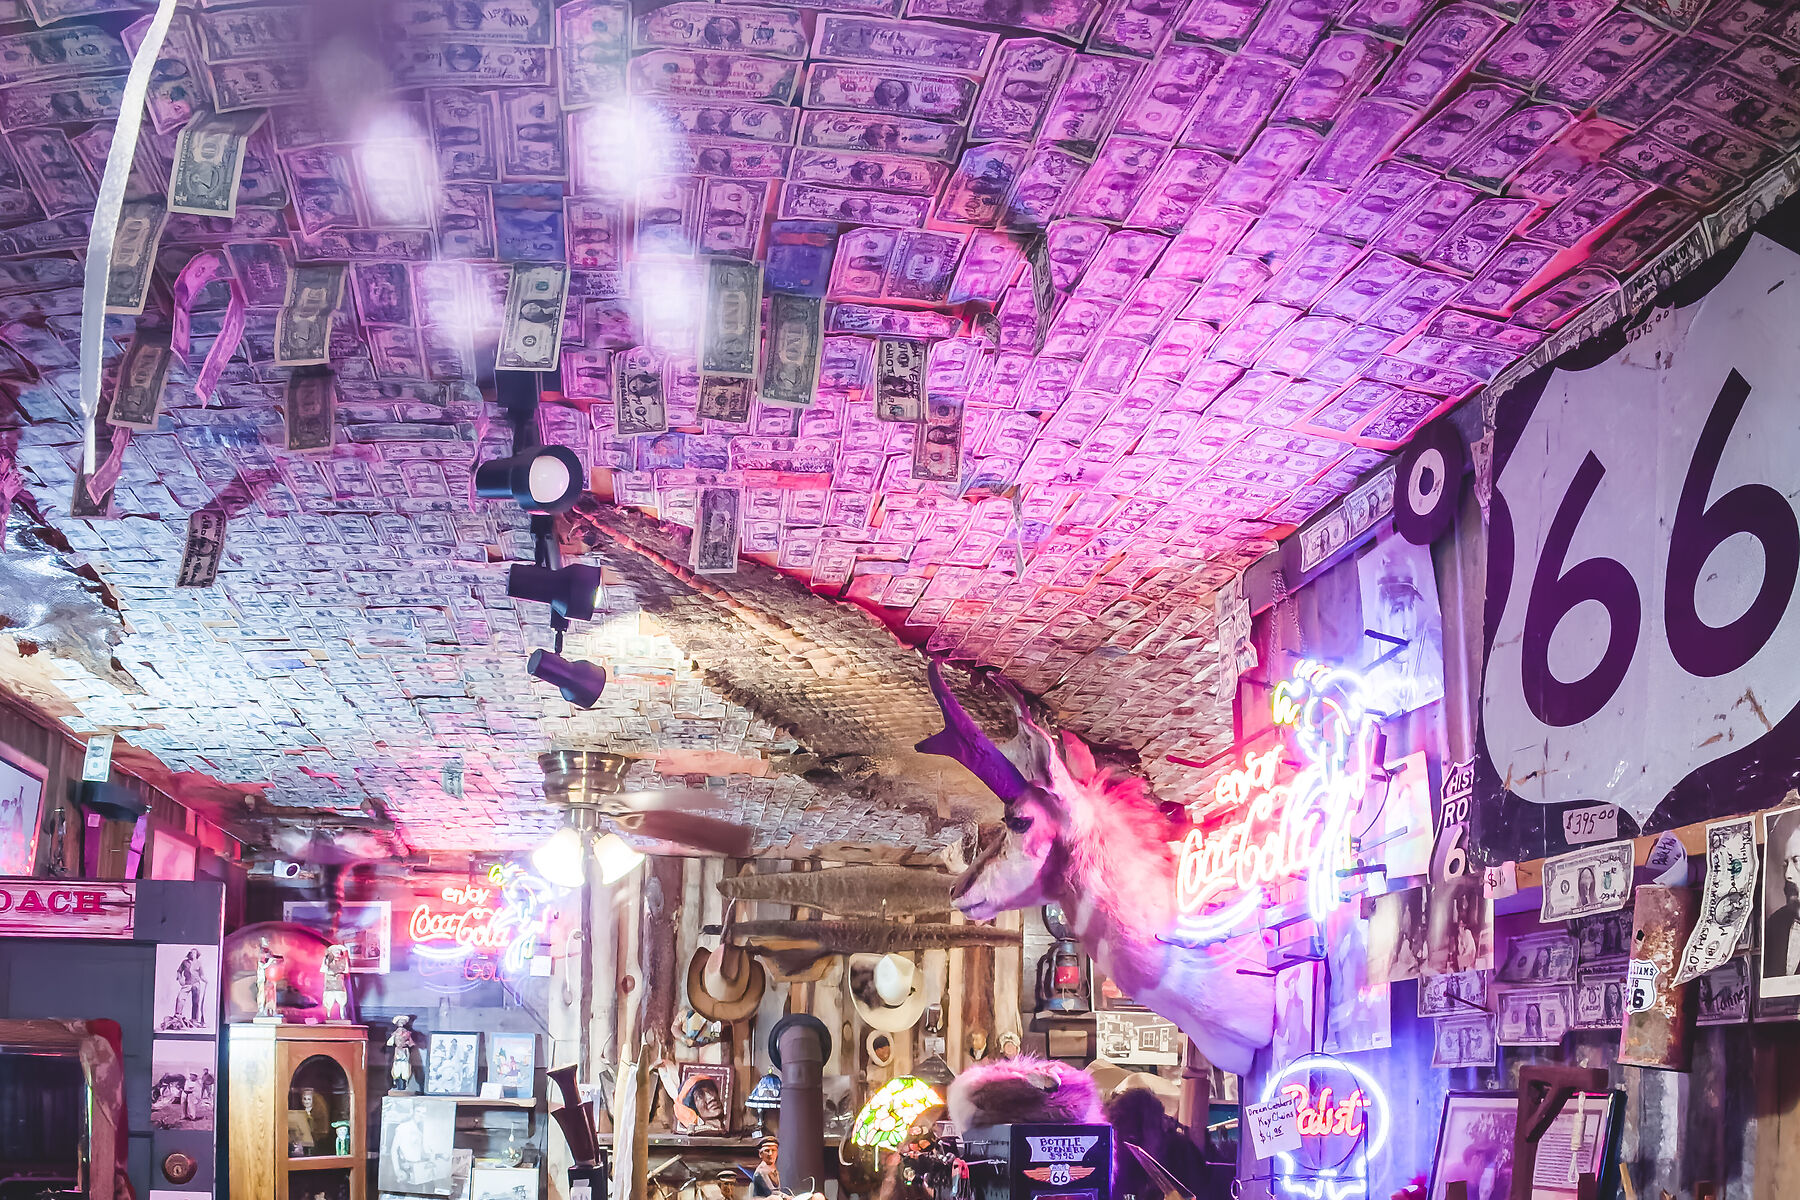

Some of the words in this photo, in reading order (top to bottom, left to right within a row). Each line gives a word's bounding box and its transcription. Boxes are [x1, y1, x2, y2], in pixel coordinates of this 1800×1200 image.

[1521, 367, 1800, 677] 66
[441, 884, 490, 905] enjoy
[1281, 1084, 1371, 1137] Pabst
[1040, 1137, 1081, 1147] BOTTLE
[1052, 1171, 1068, 1183] 66
